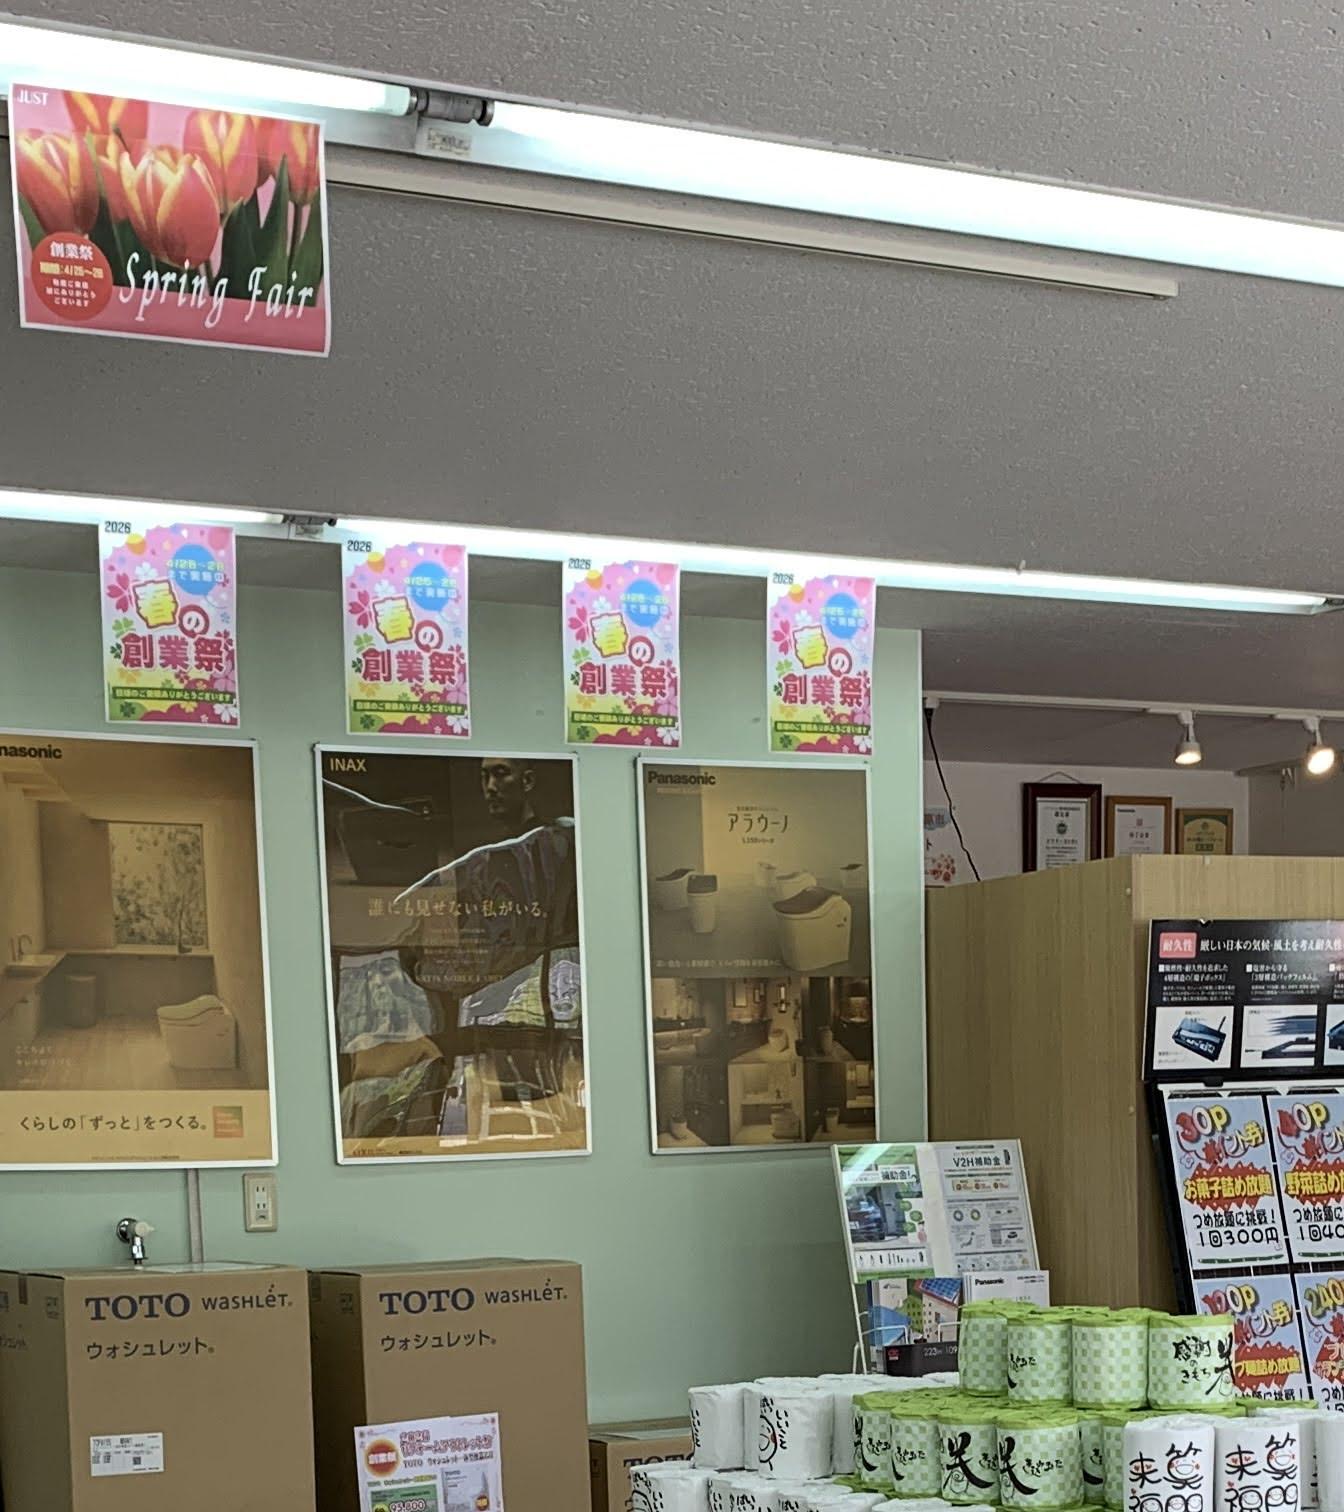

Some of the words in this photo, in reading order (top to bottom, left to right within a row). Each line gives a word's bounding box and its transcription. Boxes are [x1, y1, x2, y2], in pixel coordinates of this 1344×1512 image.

[17, 90, 48, 106] JUST
[119, 253, 229, 328] Spring
[244, 267, 314, 322] Fair
[105, 521, 131, 533] 2026
[120, 633, 226, 673] 創業祭
[579, 662, 669, 699] 創業祭
[329, 757, 367, 773] INAX
[647, 770, 717, 788] Panasonic
[728, 812, 790, 836] アラウーノ
[18, 1112, 210, 1133] くらしの「ずっと」をつくる。
[1184, 1172, 1274, 1200] お菓子詰め放題
[85, 1292, 191, 1322] TOTO
[379, 1287, 476, 1316] TOTO
